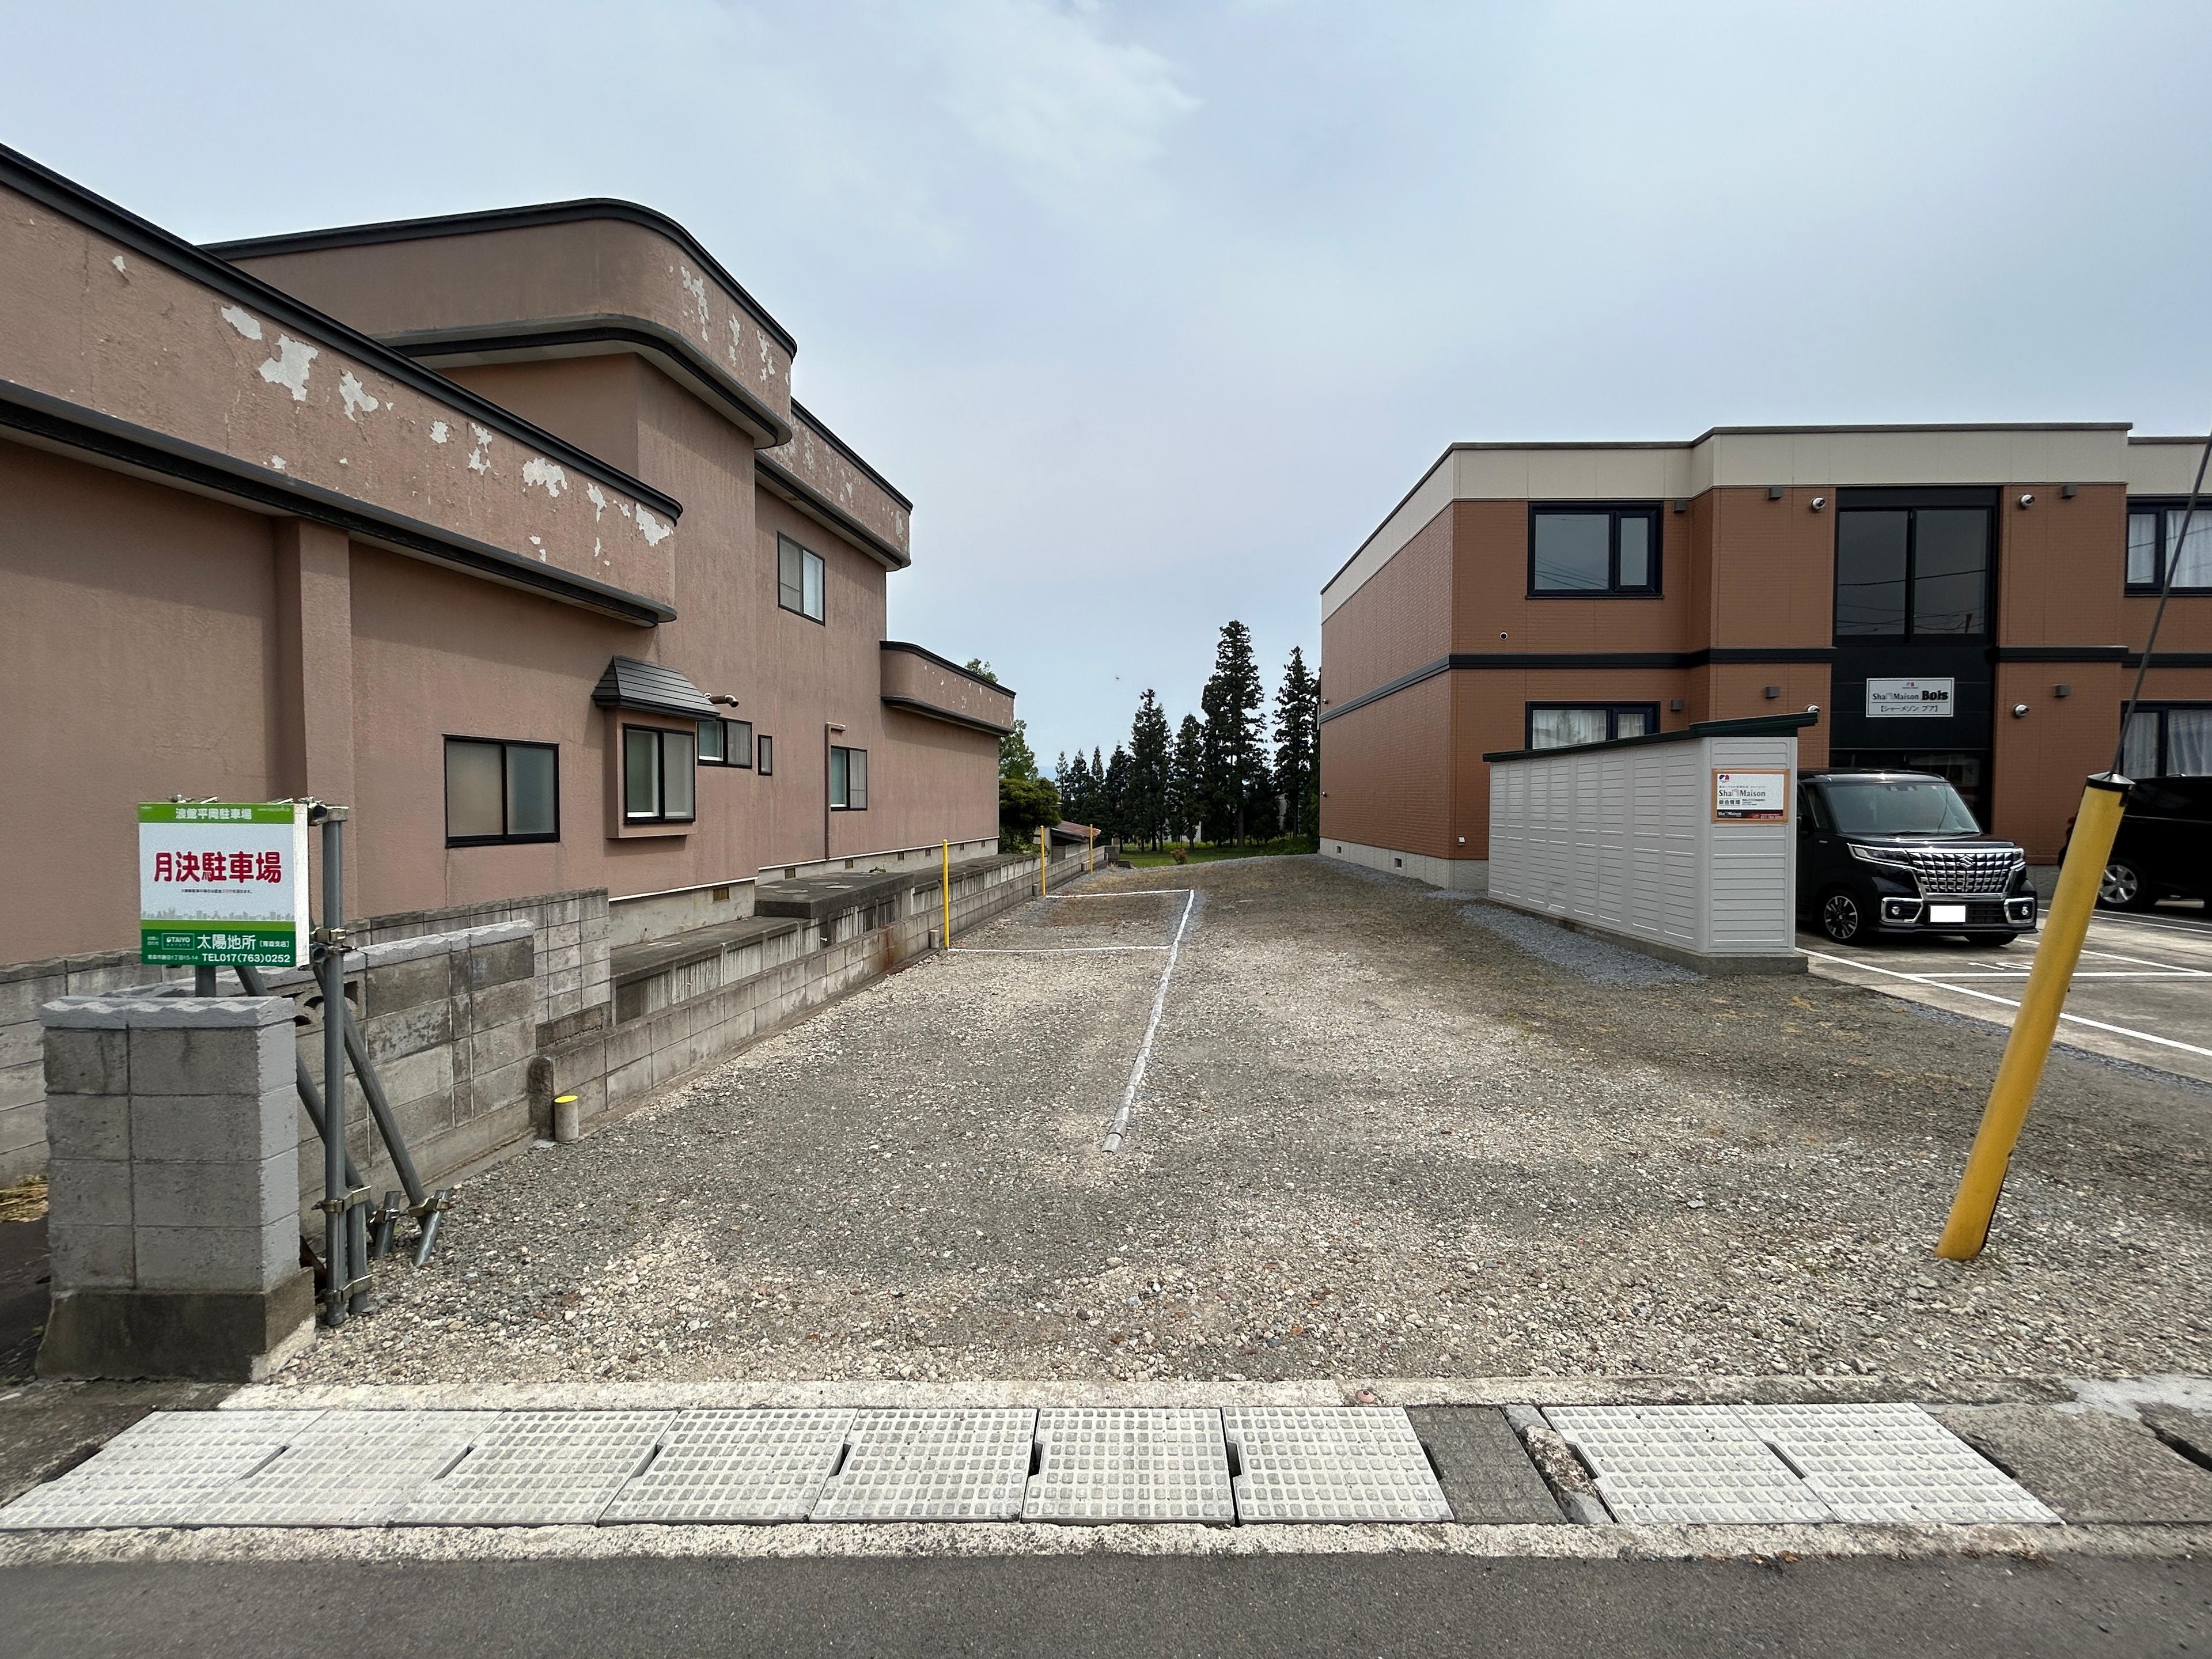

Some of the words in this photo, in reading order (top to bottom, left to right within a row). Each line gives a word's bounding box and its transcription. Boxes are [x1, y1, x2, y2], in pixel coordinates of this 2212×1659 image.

[1922, 690, 1948, 700] Bois
[154, 851, 282, 884] 月決駐車場
[197, 934, 256, 950] 太陽地所
[202, 953, 290, 963] TEL017(763)0252
